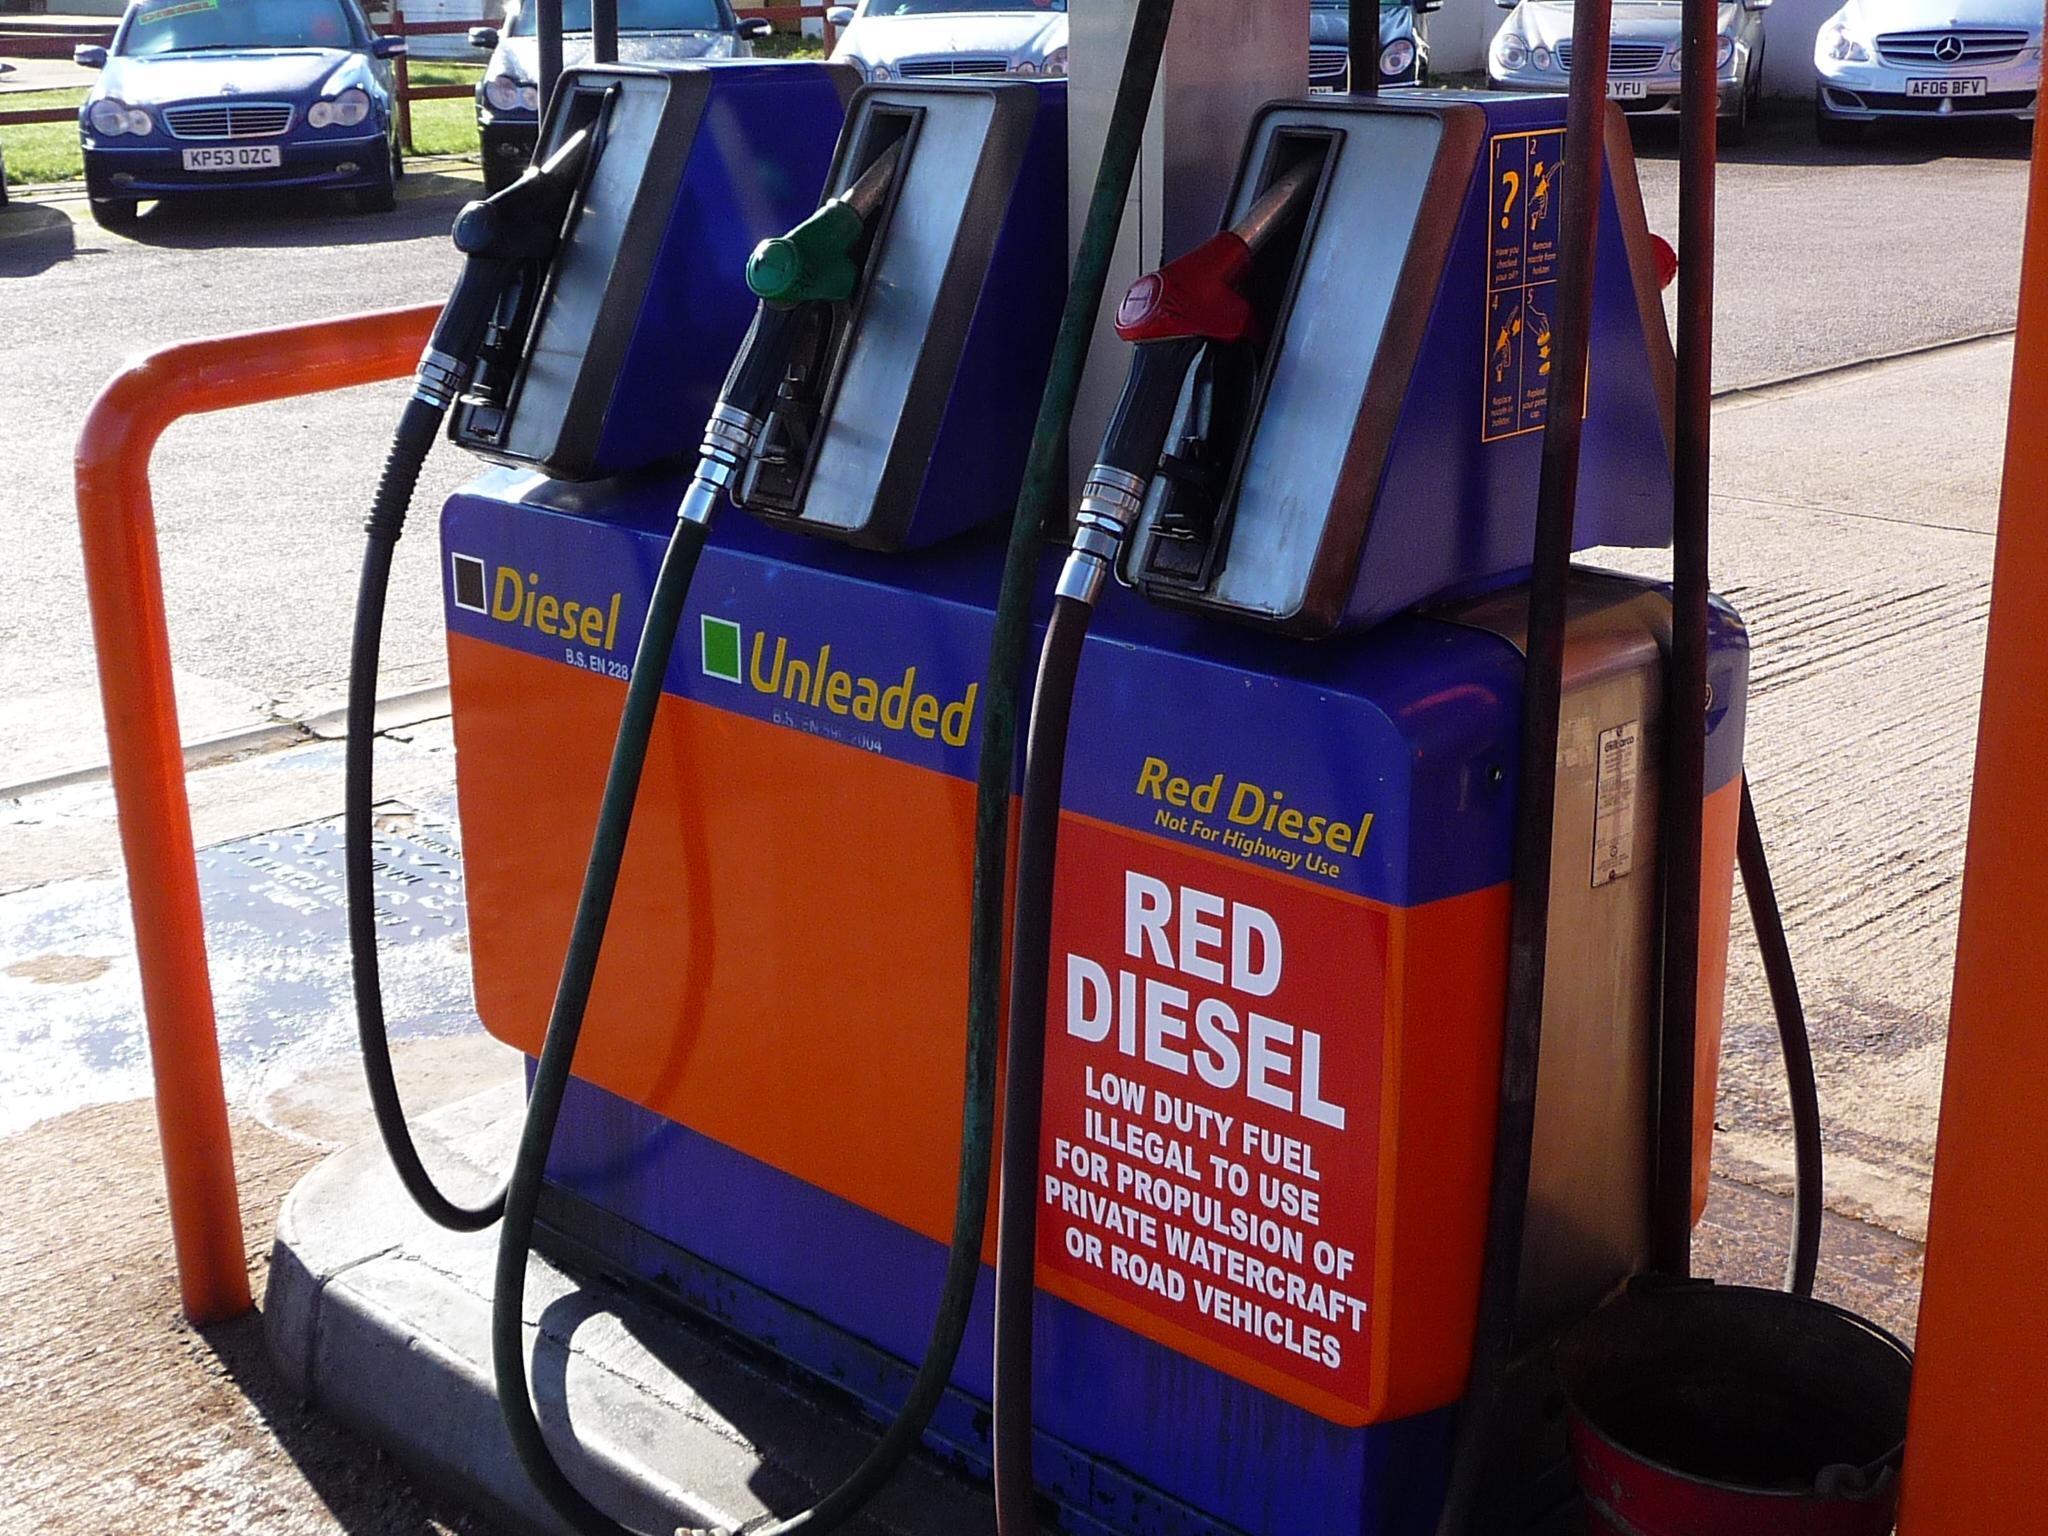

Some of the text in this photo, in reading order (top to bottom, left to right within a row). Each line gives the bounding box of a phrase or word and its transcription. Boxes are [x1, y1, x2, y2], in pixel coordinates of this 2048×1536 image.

[1614, 82, 1640, 95] YFU
[1912, 80, 1980, 95] AF06 BFV
[190, 148, 272, 167] KP53 OZC
[1529, 139, 1537, 155] 2
[1492, 294, 1498, 311] 4
[1526, 288, 1534, 304] 5
[491, 566, 622, 650] Diesel
[565, 648, 629, 681] B.S. EN 228
[750, 631, 979, 747] Unleaded
[1135, 756, 1374, 858] Red Diesel
[1154, 809, 1341, 879] Not For Highway Use
[1125, 869, 1283, 997] RED
[1067, 952, 1346, 1131] DIESEL
[1085, 1066, 1320, 1181] LOW DUTY FUEL
[1085, 1108, 1320, 1226] ILLEGAL TO USE
[1044, 1174, 1367, 1333] PRIVATE WATERCRAFT
[1055, 1137, 1355, 1282] FOR PROPULSION OF
[1065, 1226, 1342, 1370] OR ROAD VEHICLES
